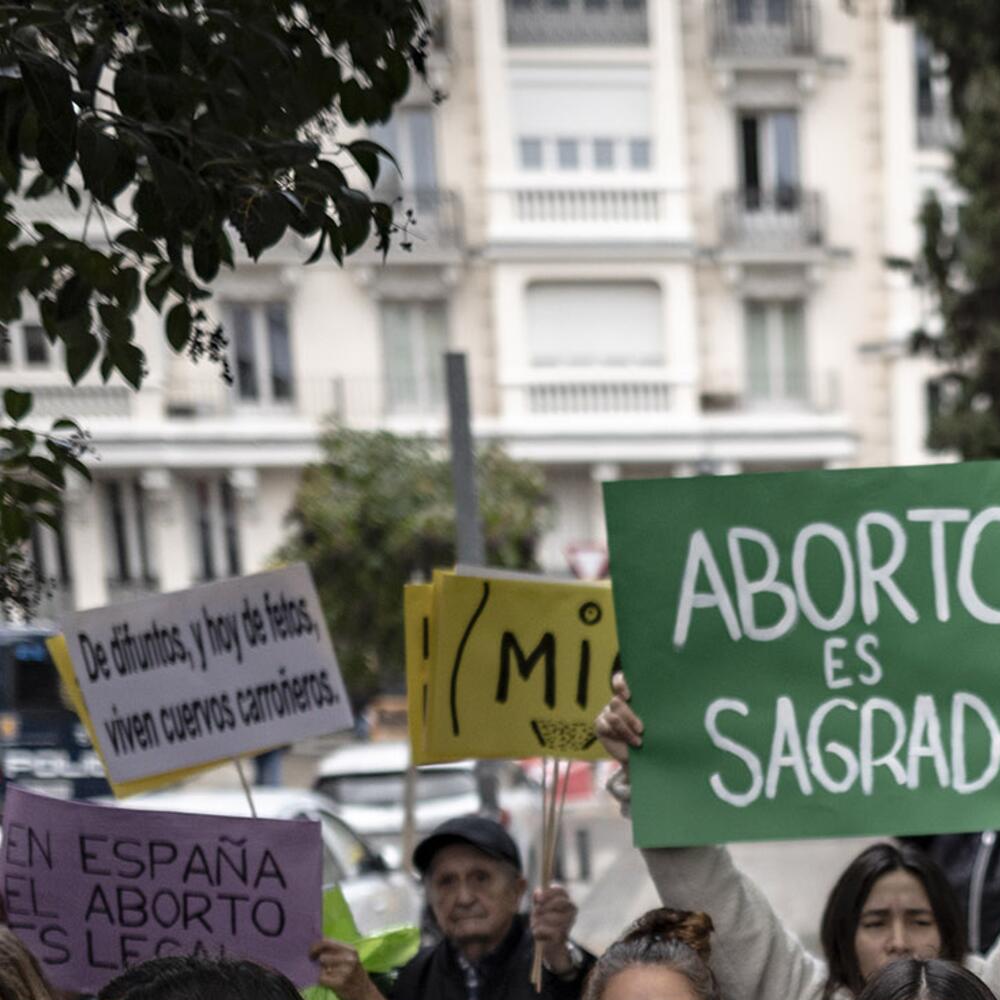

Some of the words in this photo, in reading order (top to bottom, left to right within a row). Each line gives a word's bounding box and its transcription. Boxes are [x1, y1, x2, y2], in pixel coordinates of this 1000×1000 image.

[78, 632, 111, 684] De
[110, 621, 196, 676] difuntos,
[189, 621, 208, 672] y
[202, 604, 243, 664] hoy
[242, 598, 267, 647] de
[263, 591, 321, 643] fetos,
[497, 601, 623, 711] Mi
[824, 633, 884, 689] ES
[104, 704, 160, 757] viven
[160, 690, 236, 745] cuervos
[236, 666, 340, 726] carroñeros.
[5, 821, 53, 870] EN
[78, 833, 287, 890] ESPAÑA
[4, 873, 59, 919] EL
[84, 883, 287, 938] ABORTO
